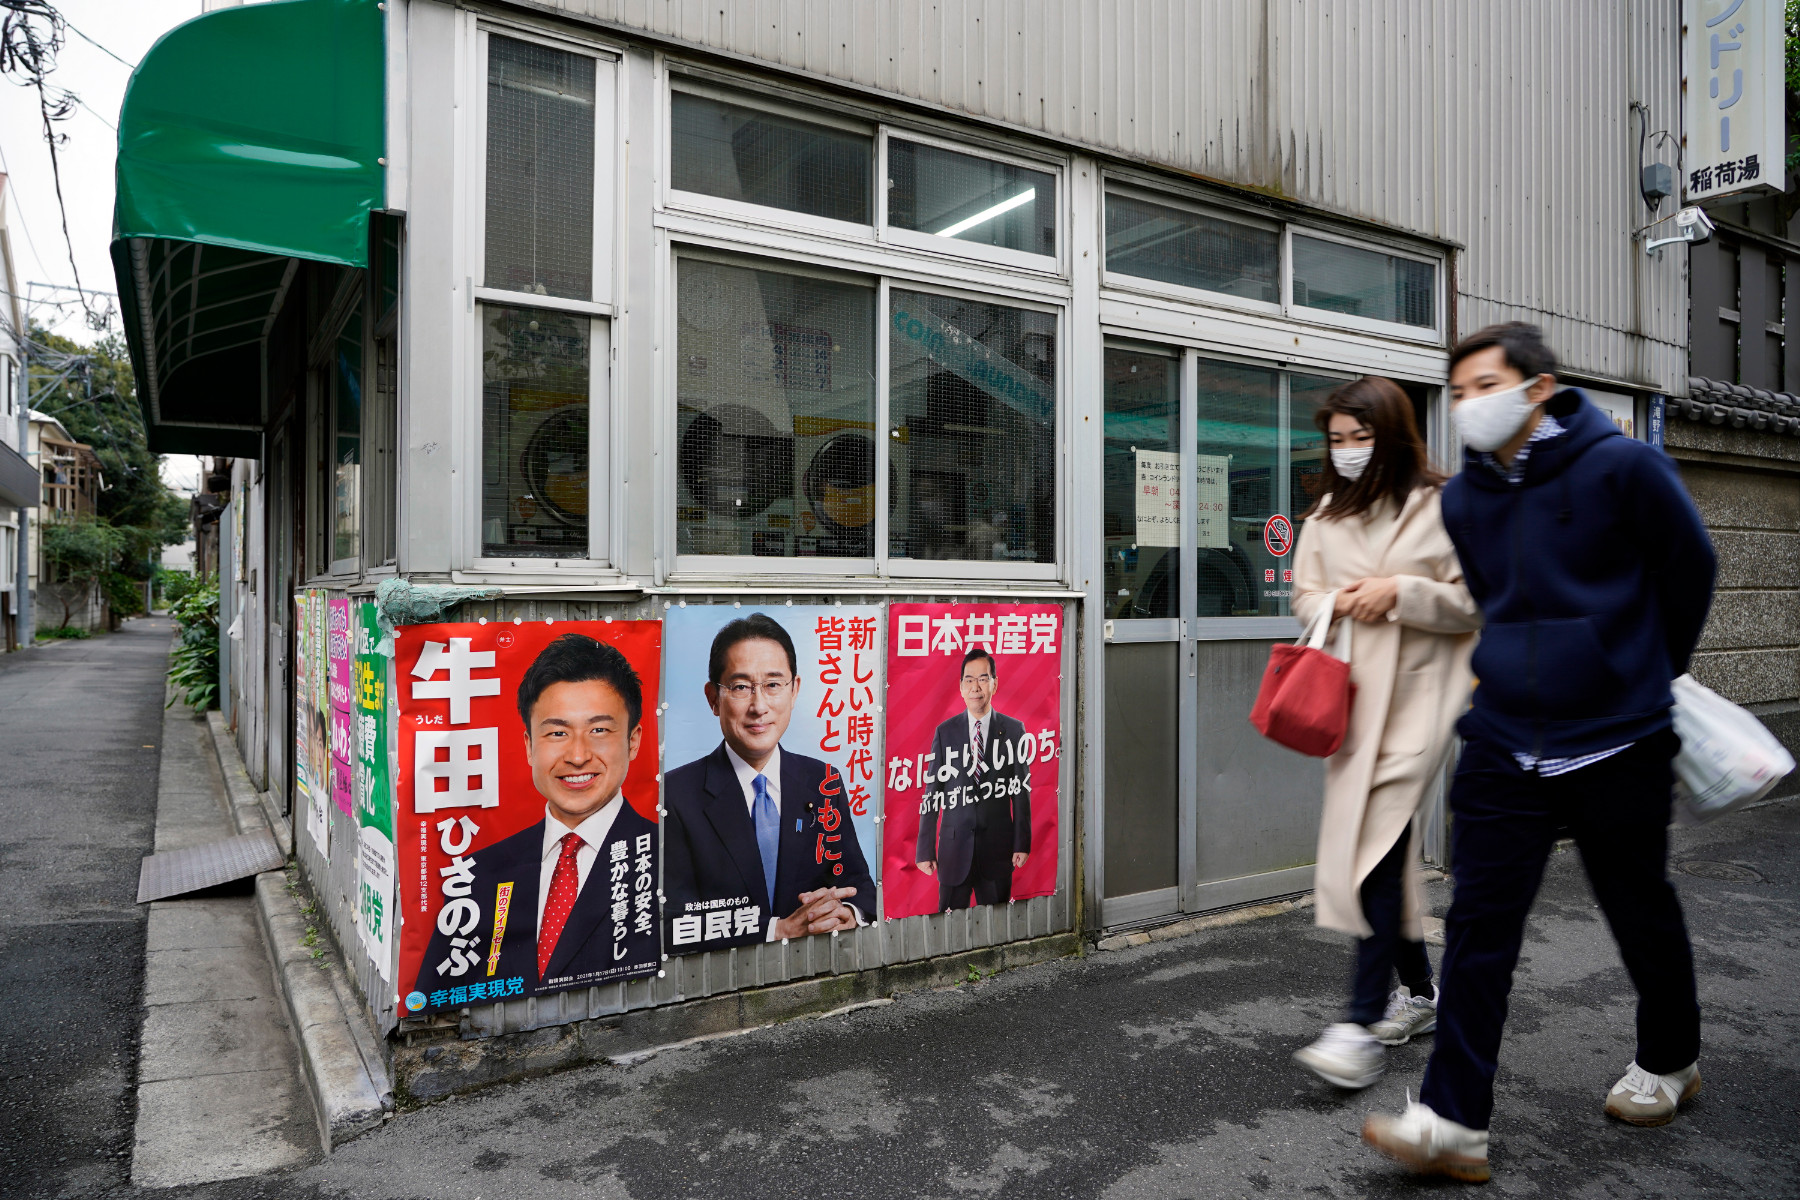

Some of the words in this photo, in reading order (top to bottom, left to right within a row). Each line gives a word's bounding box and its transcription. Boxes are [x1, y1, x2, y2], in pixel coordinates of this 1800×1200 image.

[1690, 154, 1761, 194] 稲荷湯
[897, 612, 1058, 656] 日本共産党
[815, 616, 846, 752] 皆さんと
[415, 714, 443, 725] うしだ
[847, 616, 877, 817] 新しい時代を
[919, 772, 1033, 815] ぶれずに、つらぬく
[436, 815, 481, 977] ひさのぶ
[609, 840, 629, 960] 豊かな暮らし
[684, 896, 749, 912] 政治は国民のもの
[487, 886, 511, 972] 街のライフセーバー
[672, 905, 762, 946] 自民党
[429, 976, 525, 1009] 幸福実現党
